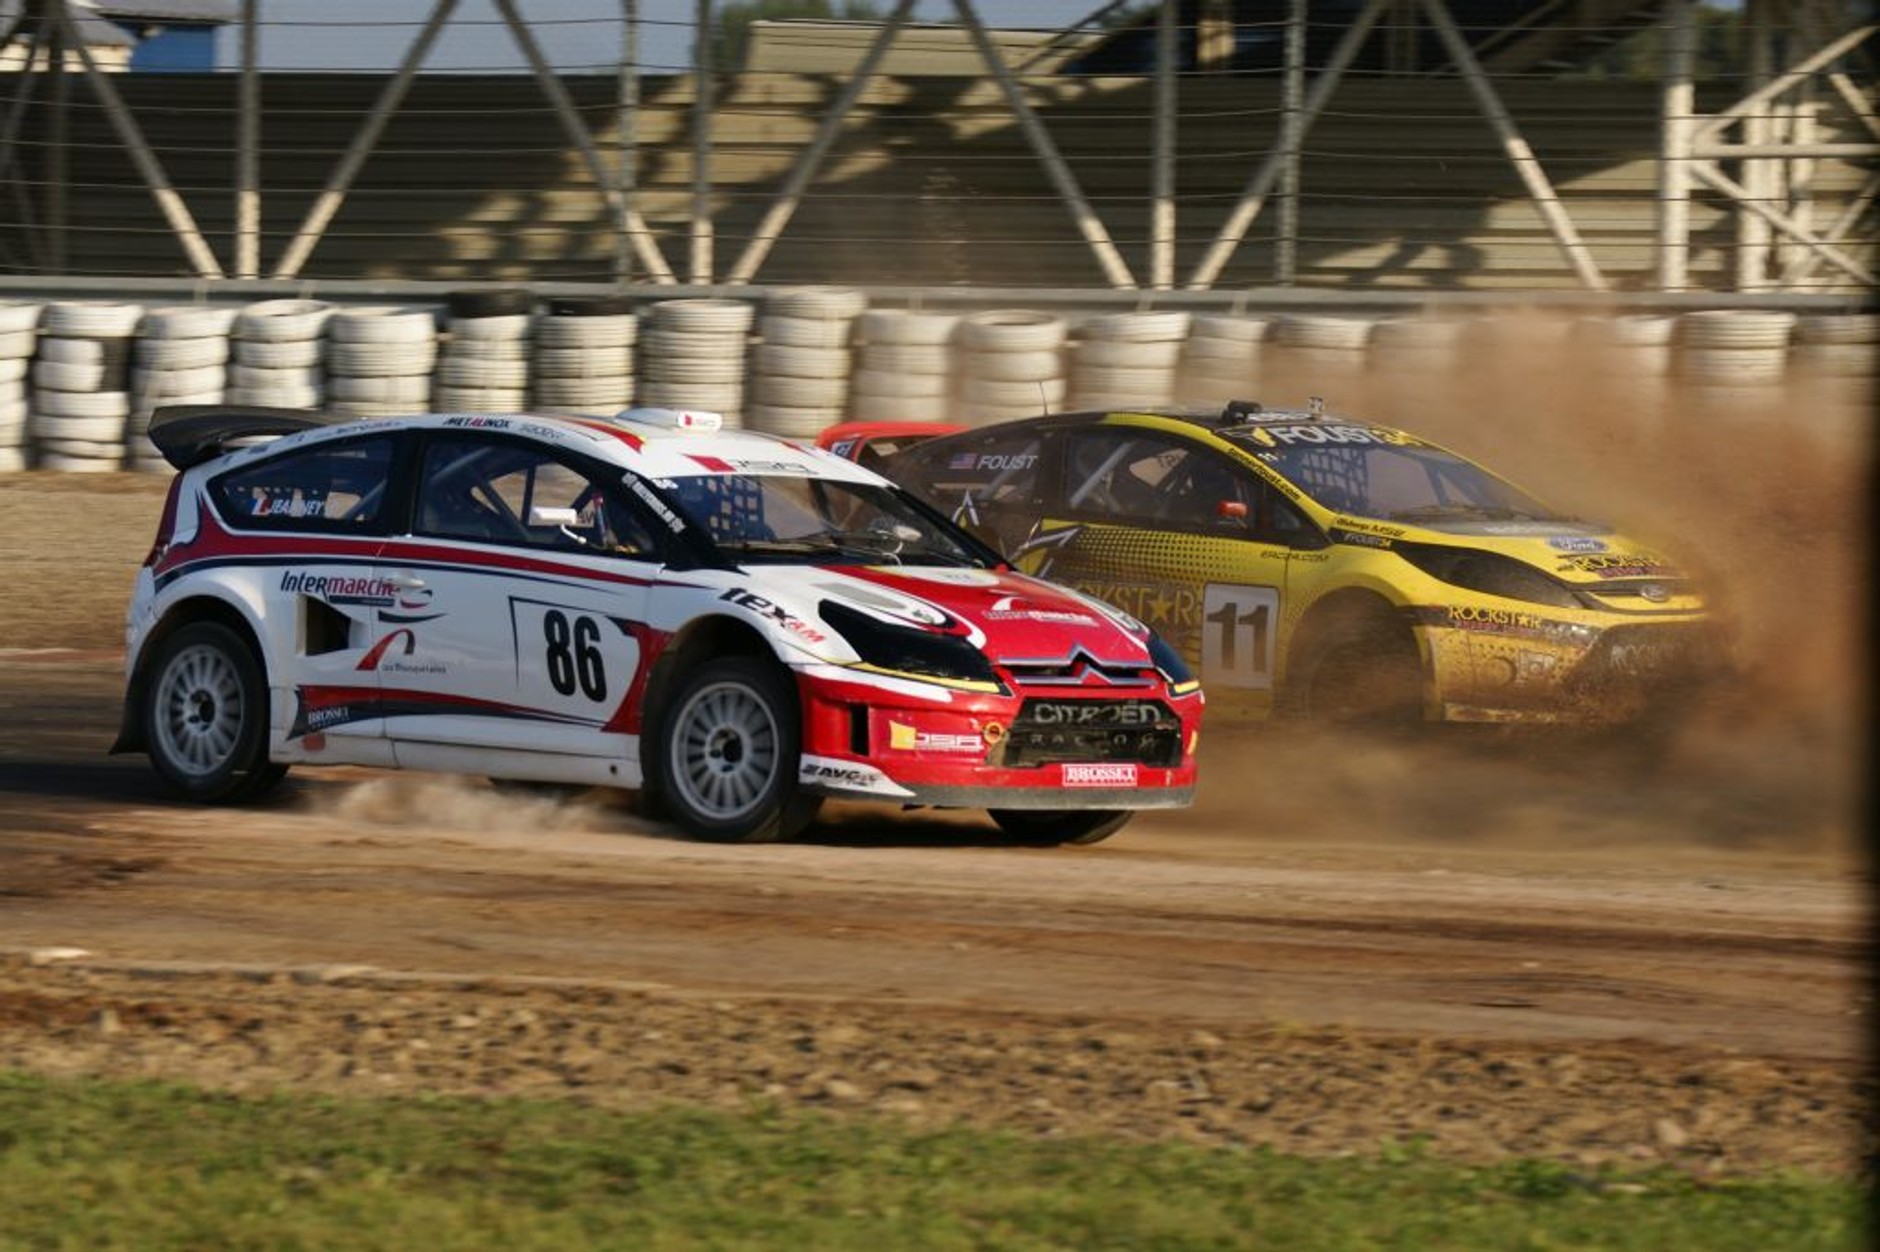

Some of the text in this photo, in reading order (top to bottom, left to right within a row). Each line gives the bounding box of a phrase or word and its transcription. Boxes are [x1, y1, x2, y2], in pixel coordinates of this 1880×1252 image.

[442, 416, 511, 429] METALINOX
[976, 455, 1038, 471] FOUST
[1206, 602, 1269, 673] 11
[543, 609, 608, 702] 86
[1066, 766, 1134, 781] BROSSET
